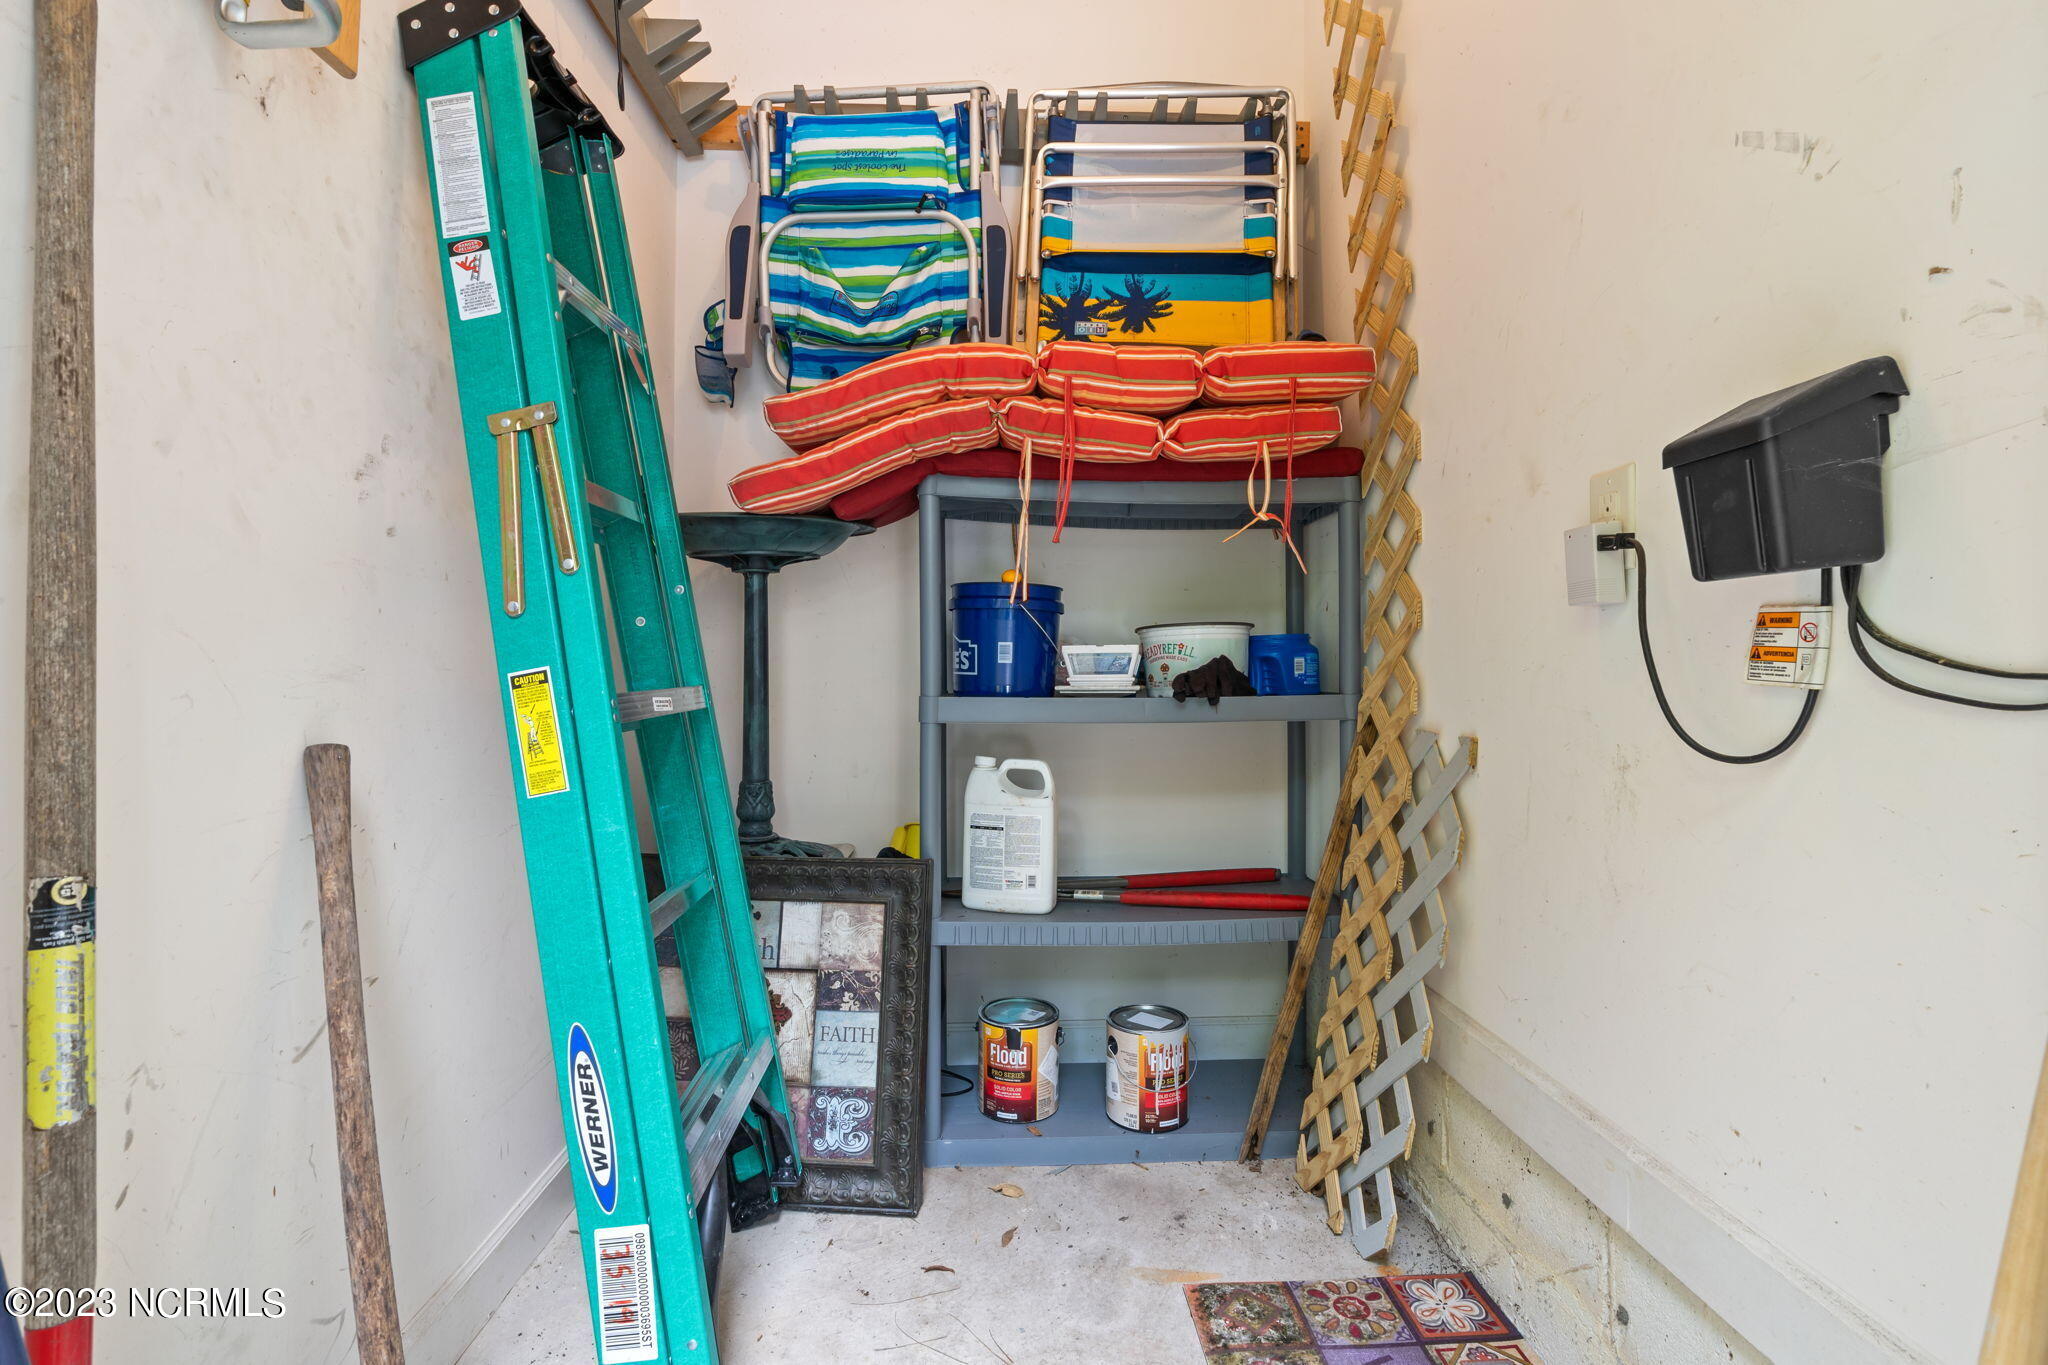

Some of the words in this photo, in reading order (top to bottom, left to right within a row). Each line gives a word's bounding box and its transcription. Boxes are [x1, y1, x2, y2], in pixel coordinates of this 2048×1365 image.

[514, 672, 545, 686] CAUTION
[820, 1025, 877, 1044] FAITH
[990, 1042, 1027, 1065] Flood
[991, 1068, 1004, 1077] PRO
[1004, 1071, 1026, 1079] SERIES
[577, 1062, 609, 1172] WERNER
